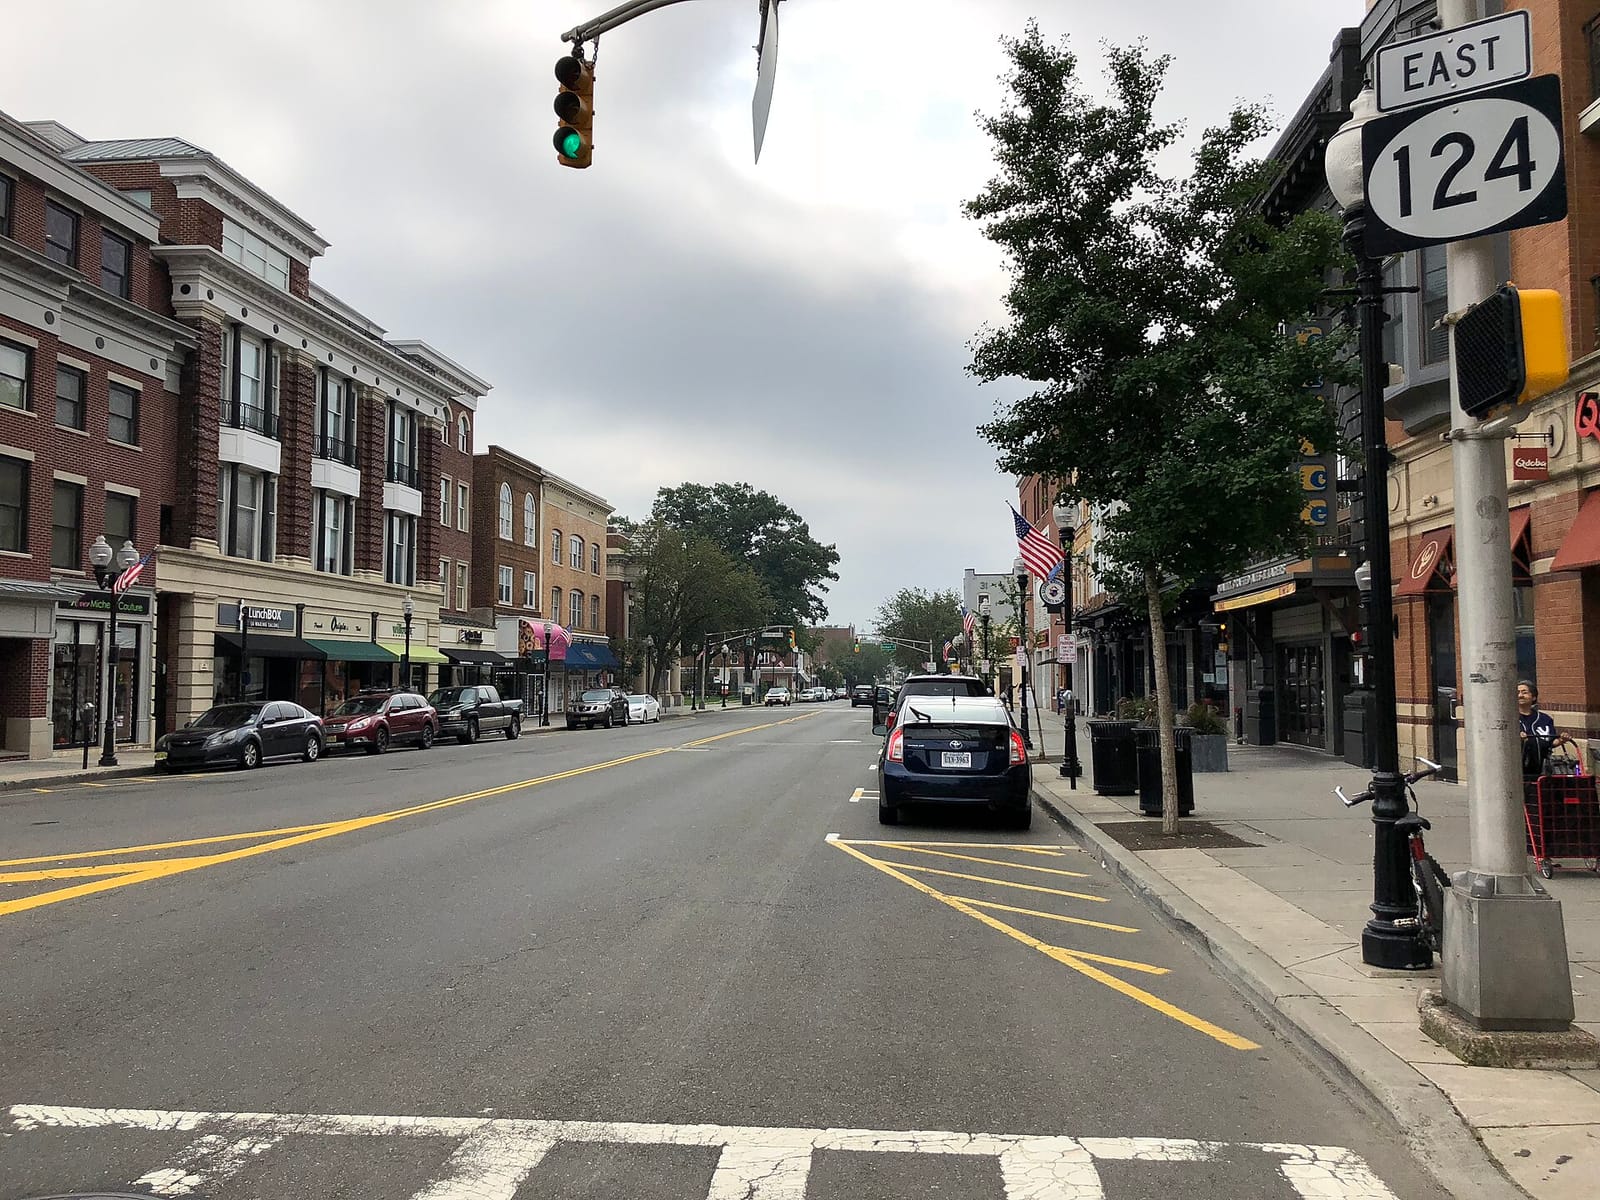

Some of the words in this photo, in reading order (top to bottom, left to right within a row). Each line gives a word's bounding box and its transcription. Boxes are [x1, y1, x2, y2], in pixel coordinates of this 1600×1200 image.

[1403, 35, 1500, 92] EAST
[1392, 115, 1536, 218] 124
[1515, 458, 1547, 470] Qdoba
[980, 581, 988, 590] 31
[118, 601, 143, 611] Couture
[248, 607, 281, 620] LunchBOX
